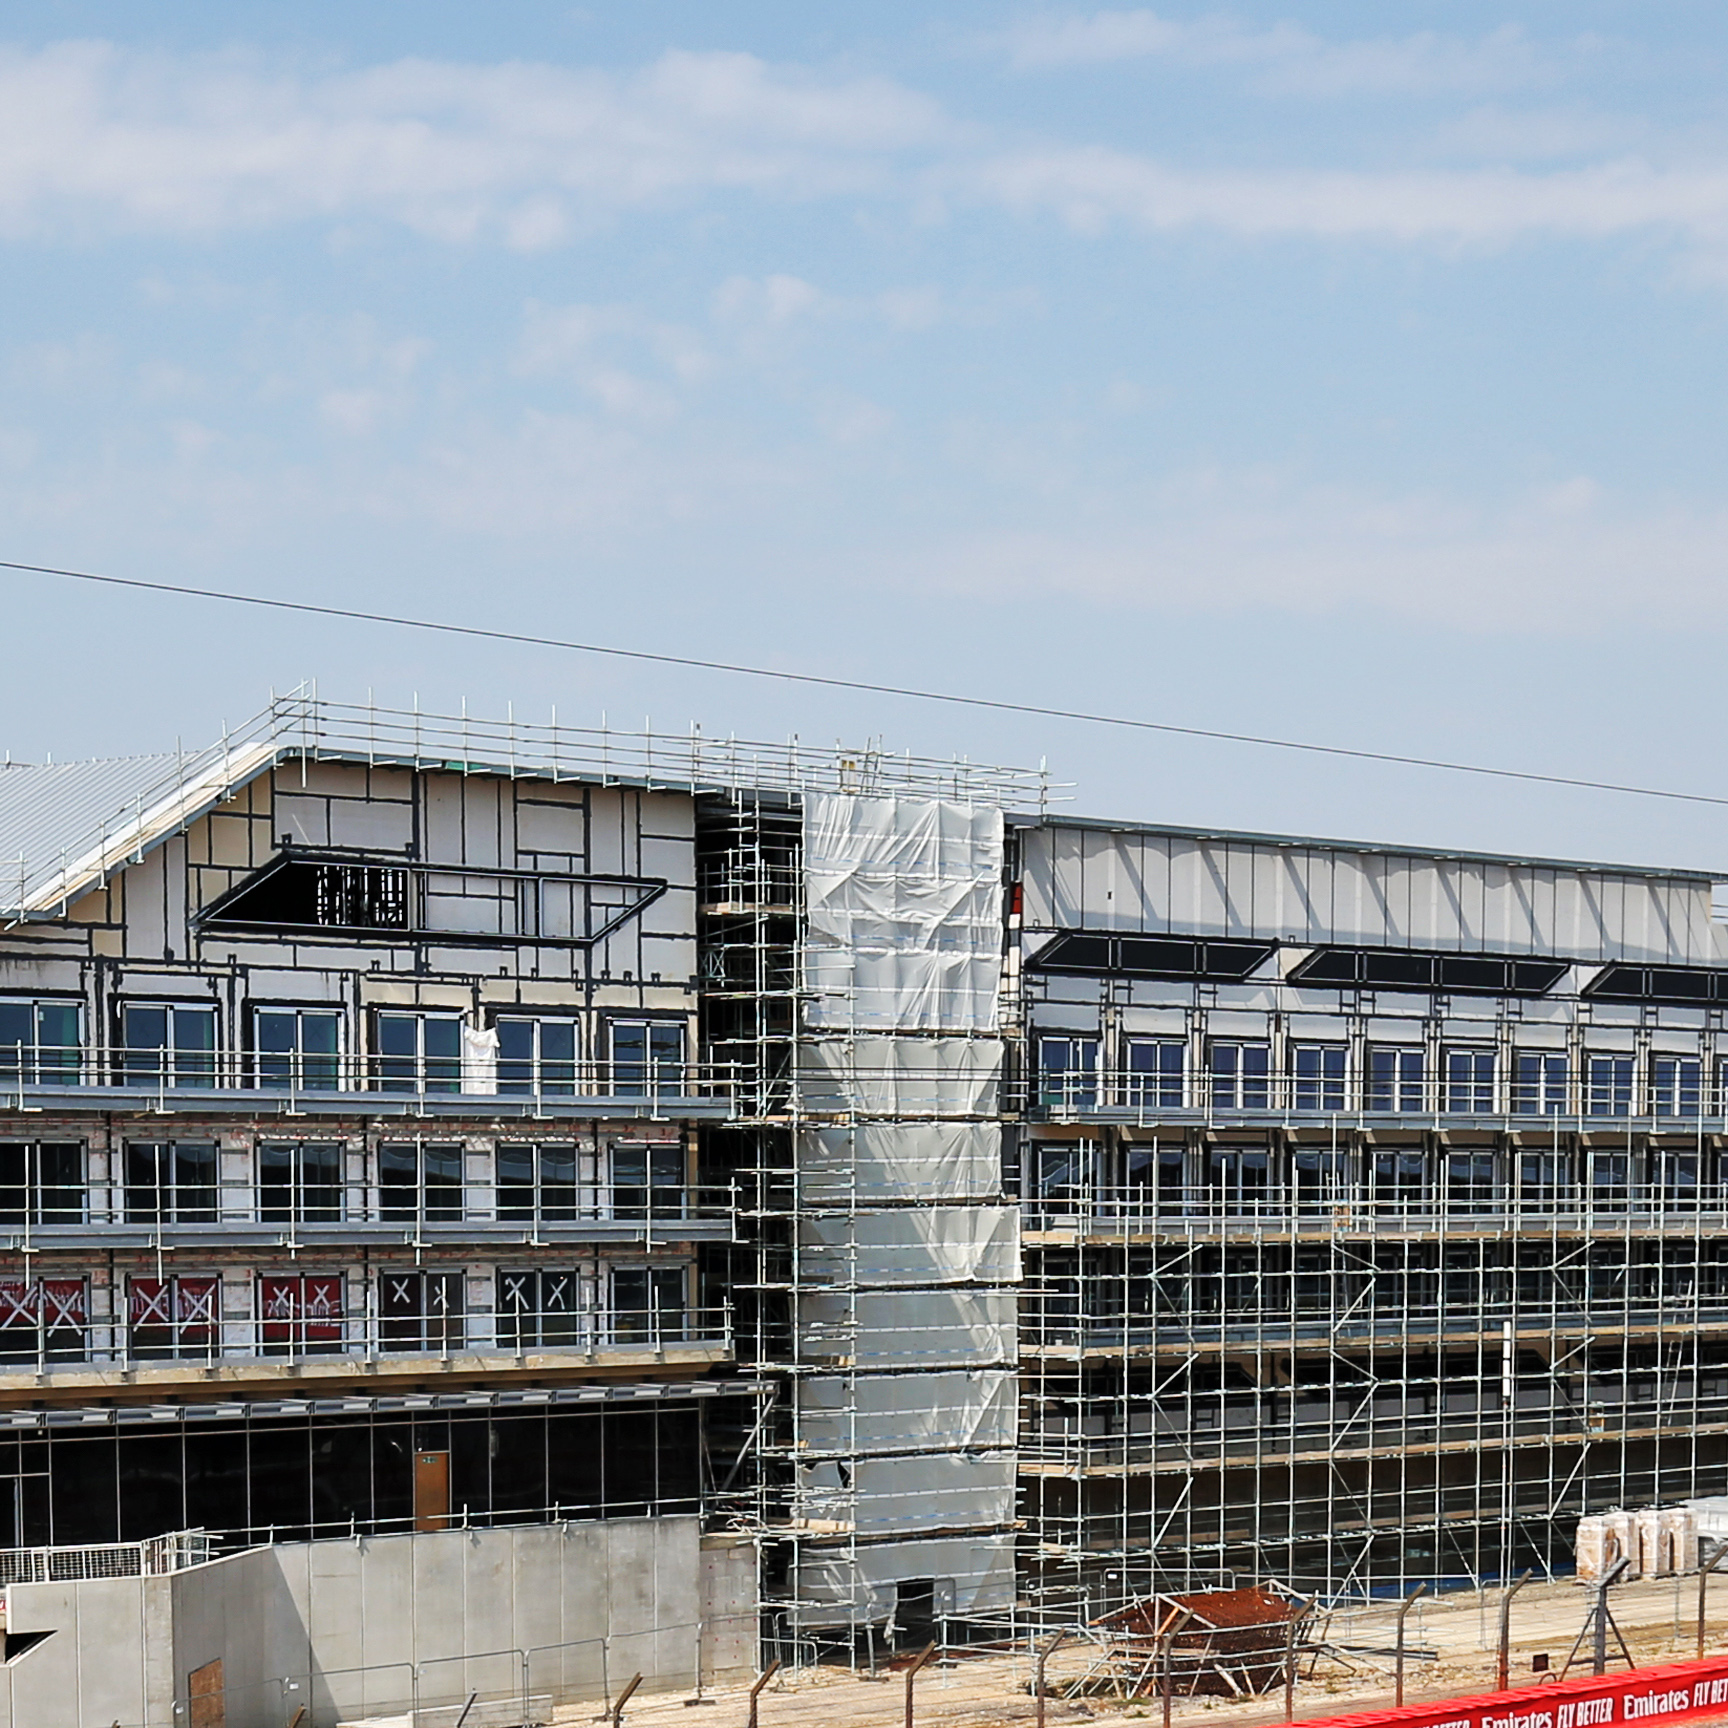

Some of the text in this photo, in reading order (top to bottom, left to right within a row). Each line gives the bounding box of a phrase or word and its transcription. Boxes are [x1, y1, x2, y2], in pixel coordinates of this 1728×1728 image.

[1576, 1697, 1614, 1727] BETTER
[1623, 1689, 1689, 1720] Emirates
[1693, 1681, 1711, 1707] FLY
